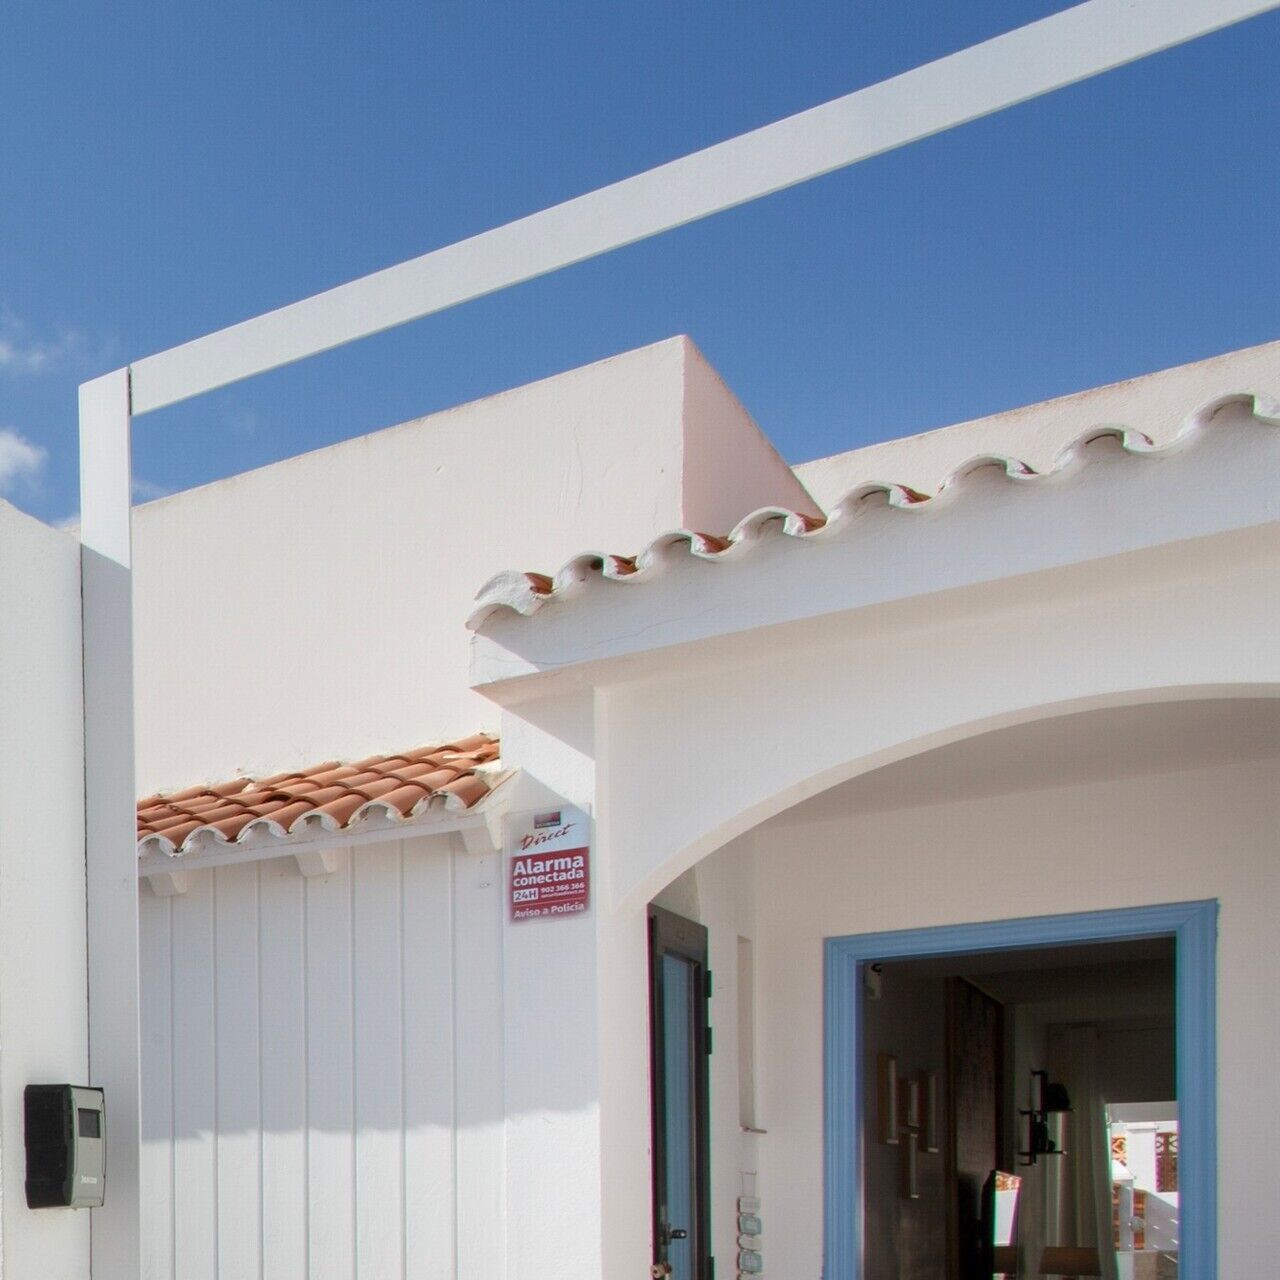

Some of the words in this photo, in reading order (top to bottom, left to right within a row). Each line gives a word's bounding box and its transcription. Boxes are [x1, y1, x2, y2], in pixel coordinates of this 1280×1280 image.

[521, 823, 576, 850] Direct
[513, 855, 585, 876] Alarma
[513, 868, 585, 887] conectada
[515, 889, 537, 901] 24H
[514, 907, 541, 919] Aviso
[543, 907, 549, 915] a
[551, 901, 585, 914] Policía
